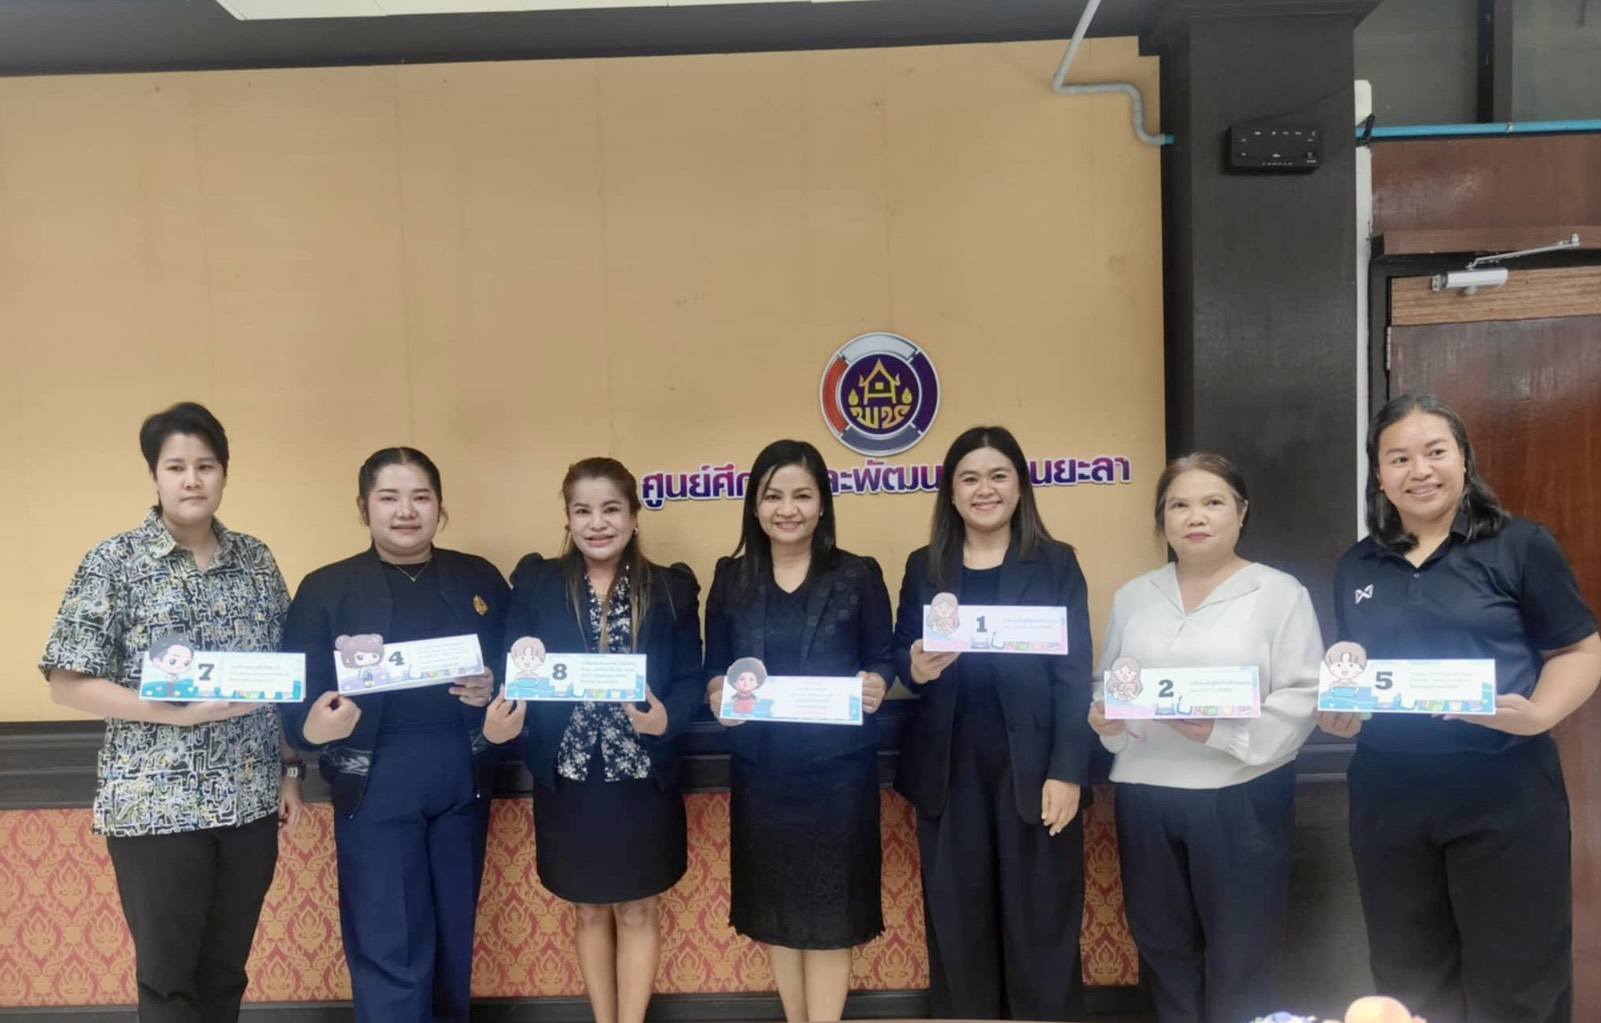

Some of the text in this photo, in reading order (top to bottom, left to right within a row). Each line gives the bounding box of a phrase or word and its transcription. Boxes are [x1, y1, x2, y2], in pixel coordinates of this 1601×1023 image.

[976, 616, 988, 633] 1
[388, 651, 405, 666] 4
[198, 663, 214, 681] 7
[552, 663, 568, 680] 8
[1158, 679, 1174, 698] 2
[1375, 671, 1393, 690] 5
